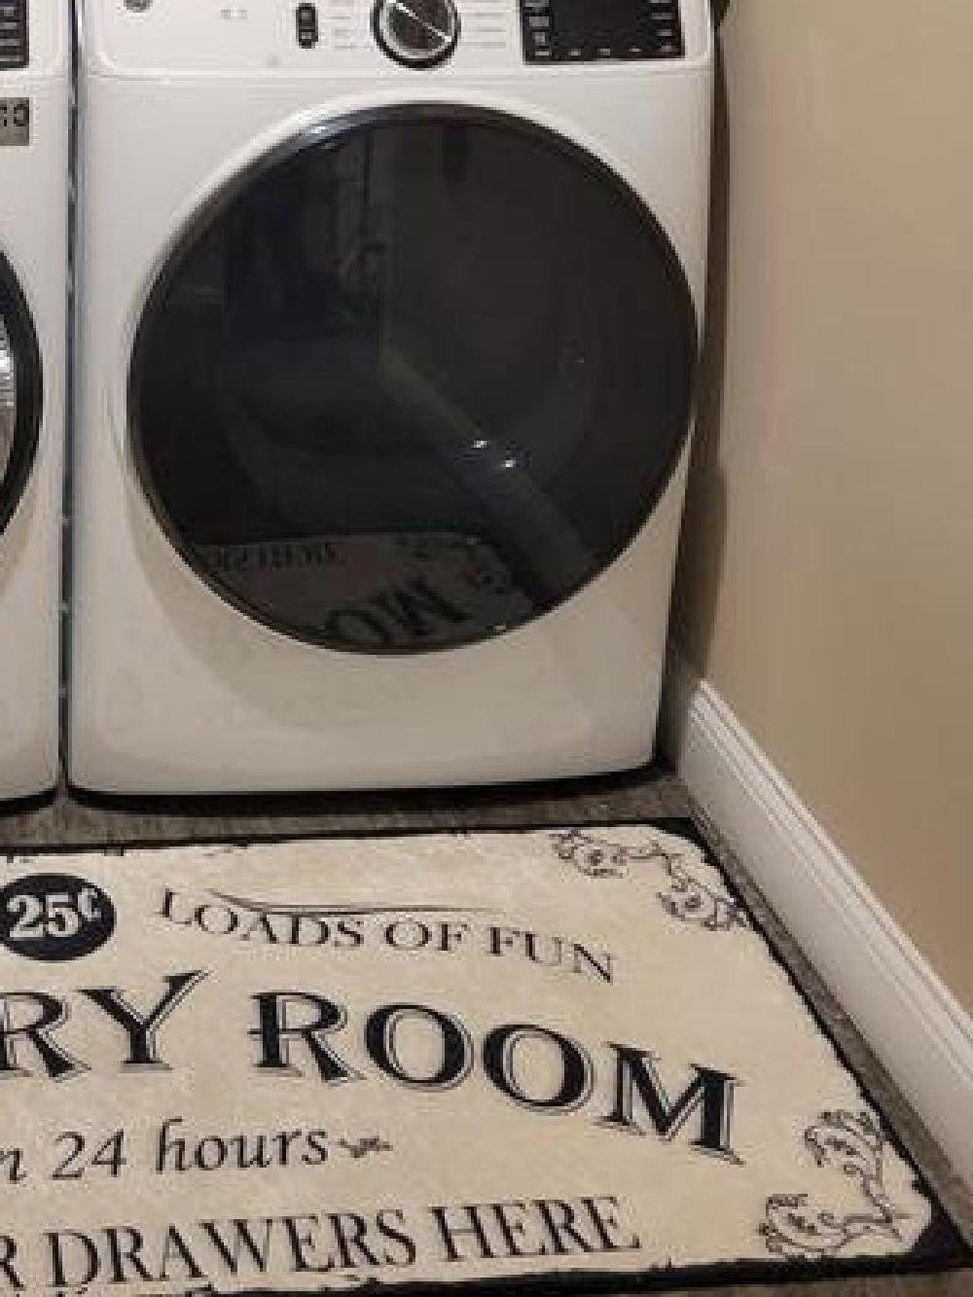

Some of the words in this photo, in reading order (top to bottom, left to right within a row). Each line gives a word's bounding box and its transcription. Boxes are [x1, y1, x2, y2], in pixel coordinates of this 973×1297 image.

[159, 887, 365, 948] LOADS
[384, 914, 470, 953] OF
[486, 924, 616, 985] FUN
[247, 989, 746, 1167] ROOM
[50, 1128, 128, 1181] 24
[153, 1115, 329, 1176] hours
[42, 1207, 420, 1289] DRAWERS
[427, 1195, 643, 1263] HERE
